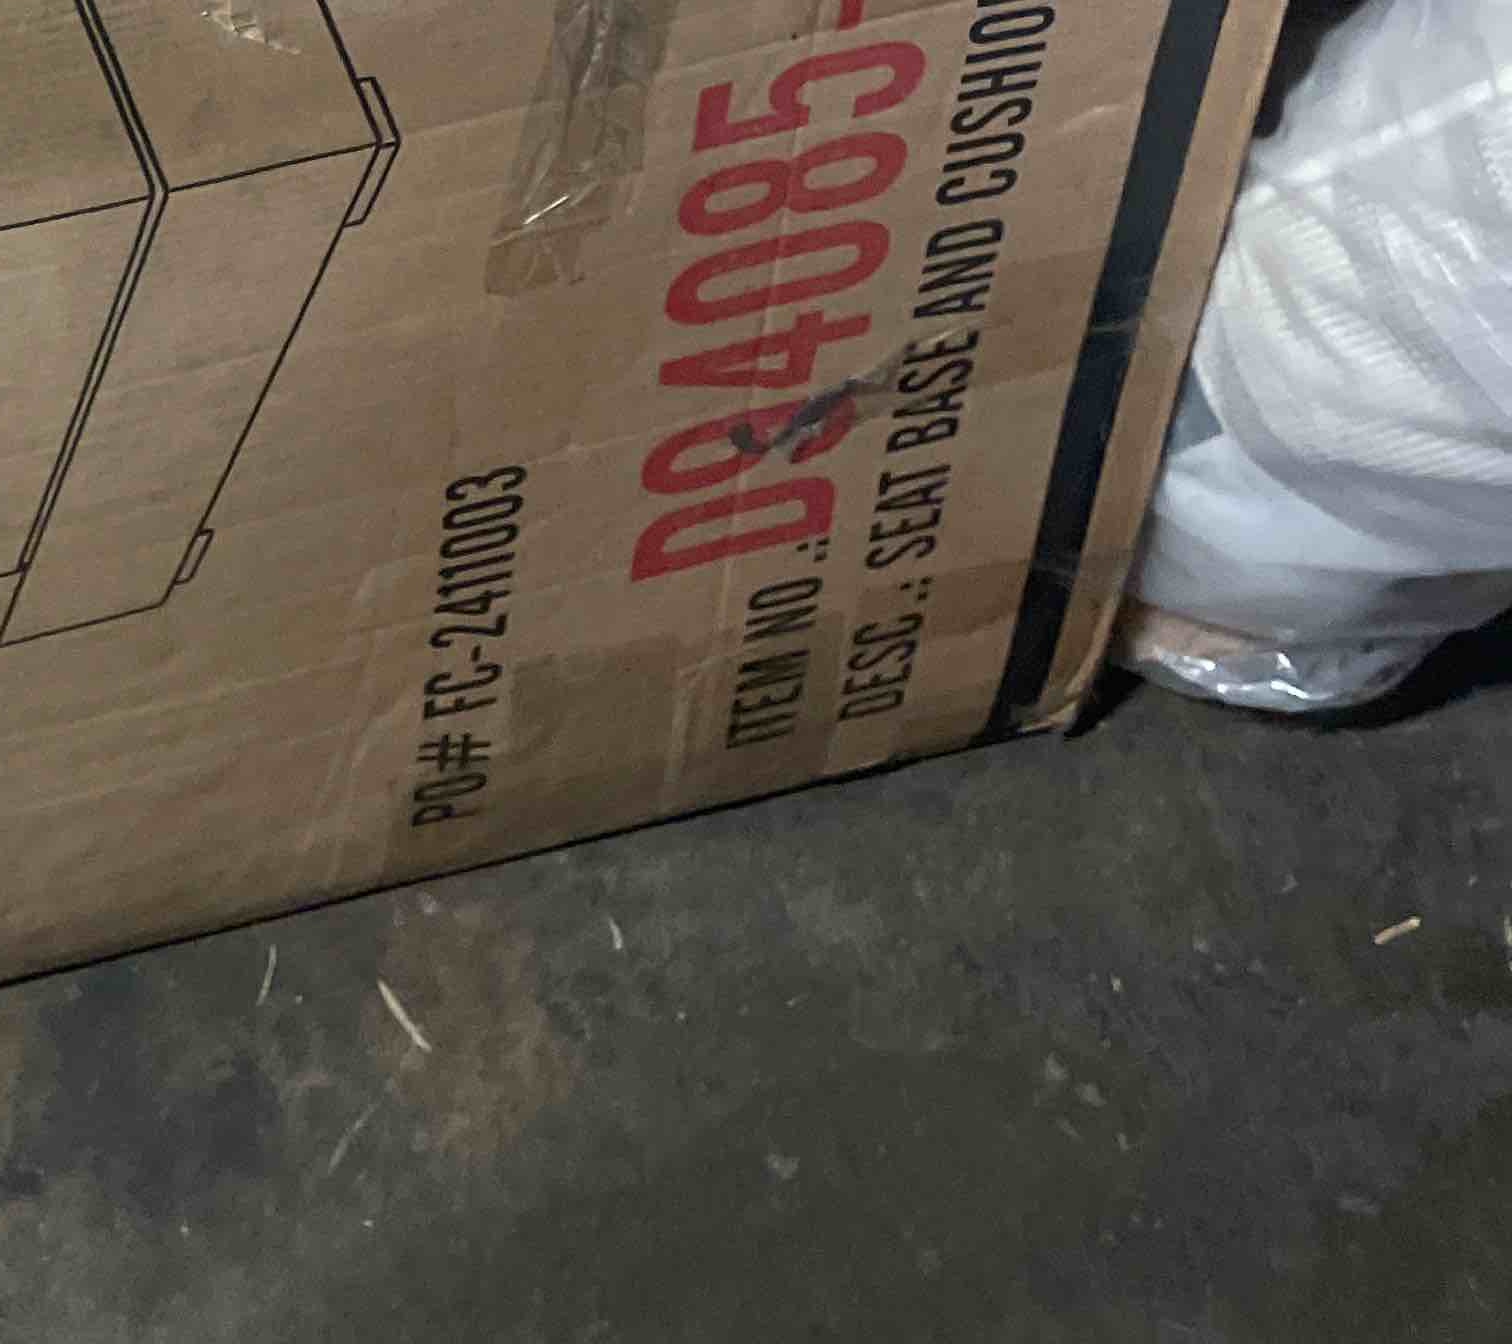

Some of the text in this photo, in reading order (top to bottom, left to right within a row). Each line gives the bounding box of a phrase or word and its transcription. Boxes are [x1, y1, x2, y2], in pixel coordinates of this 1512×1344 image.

[913, 217, 1005, 320] AND
[886, 326, 979, 454] BASE
[865, 464, 952, 570] SEAT
[411, 464, 528, 827] PO# FC-2411003
[744, 575, 824, 643] NO
[725, 648, 811, 750] ITEM
[838, 613, 924, 722] DESC
